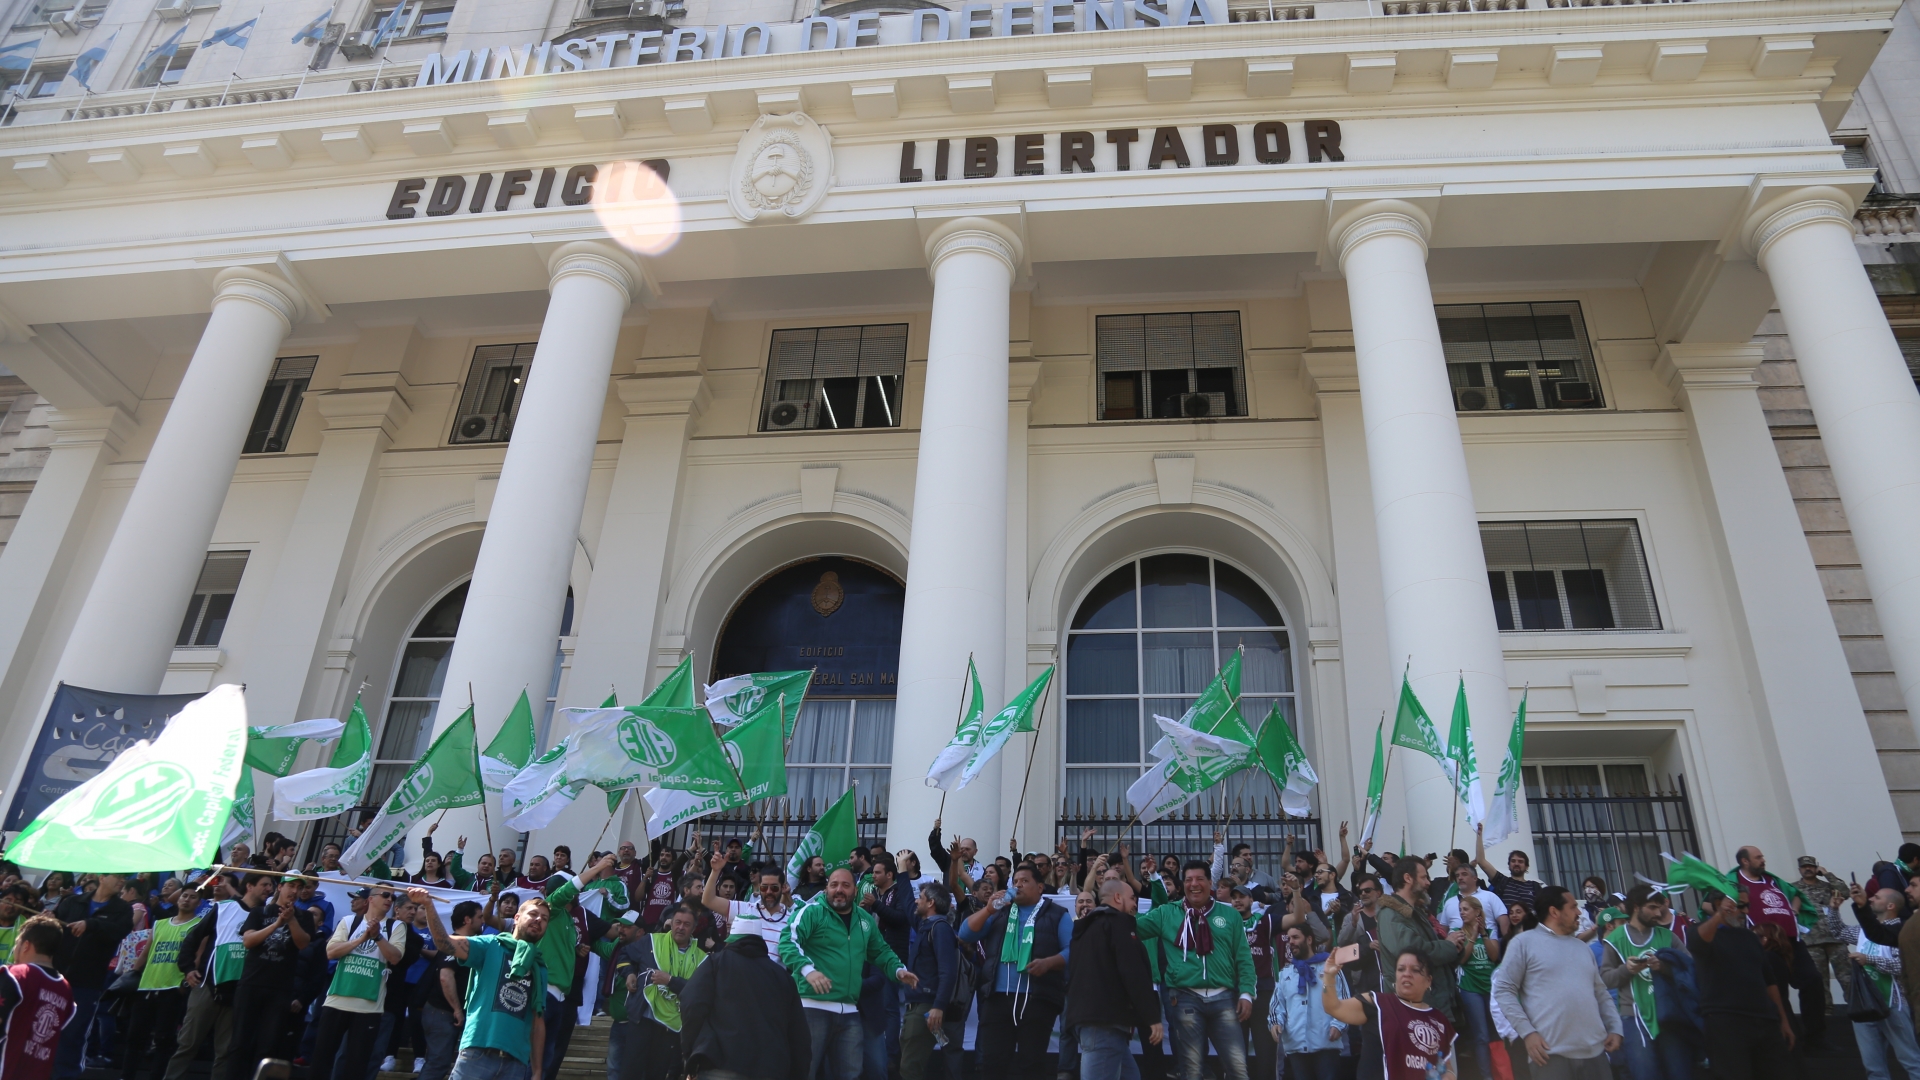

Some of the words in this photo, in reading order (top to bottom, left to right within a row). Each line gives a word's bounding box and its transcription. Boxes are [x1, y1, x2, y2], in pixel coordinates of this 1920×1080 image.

[415, 22, 773, 87] MINISTERIO
[800, 13, 880, 51] DE
[912, 0, 1217, 42] DEFENSA
[386, 158, 671, 220] EDIFICIO
[899, 119, 1345, 183] LIBERTADOR
[800, 646, 844, 657] EDIFICIO
[811, 672, 844, 686] ERAL
[850, 672, 874, 685] SAN
[880, 672, 896, 685] MA
[39, 784, 71, 795] Centra
[228, 944, 248, 952] BIBLI
[231, 951, 245, 959] NAC
[1405, 1053, 1428, 1071] ORGAN
